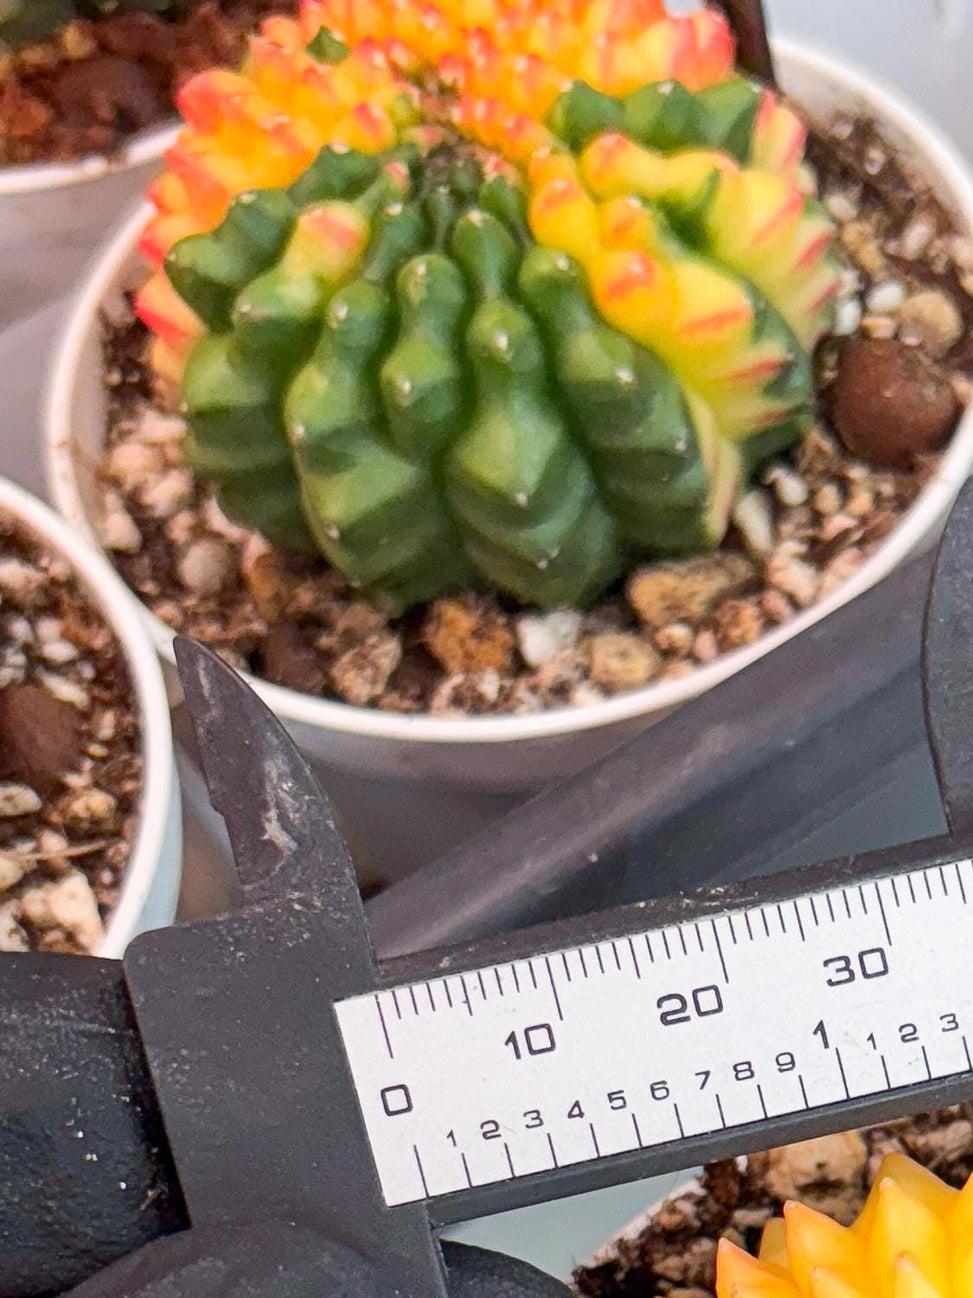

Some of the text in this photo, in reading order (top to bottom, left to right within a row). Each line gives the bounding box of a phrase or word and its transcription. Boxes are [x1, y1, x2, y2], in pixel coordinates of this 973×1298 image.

[380, 1083, 413, 1116] 0
[505, 1023, 556, 1060] 10
[656, 984, 723, 1026] 20
[823, 947, 889, 987] 30
[446, 1129, 457, 1147] 1
[480, 1119, 502, 1140] 2
[523, 1109, 544, 1129] 3
[567, 1100, 584, 1120] 4
[607, 1089, 627, 1111] 5
[650, 1080, 670, 1100] 6
[694, 1070, 711, 1090] 7
[733, 1061, 755, 1081] 8
[775, 1052, 795, 1072] 9
[812, 1020, 830, 1049] 1
[866, 1032, 877, 1050] 1
[899, 1023, 918, 1042] 2
[940, 1013, 960, 1032] 3
